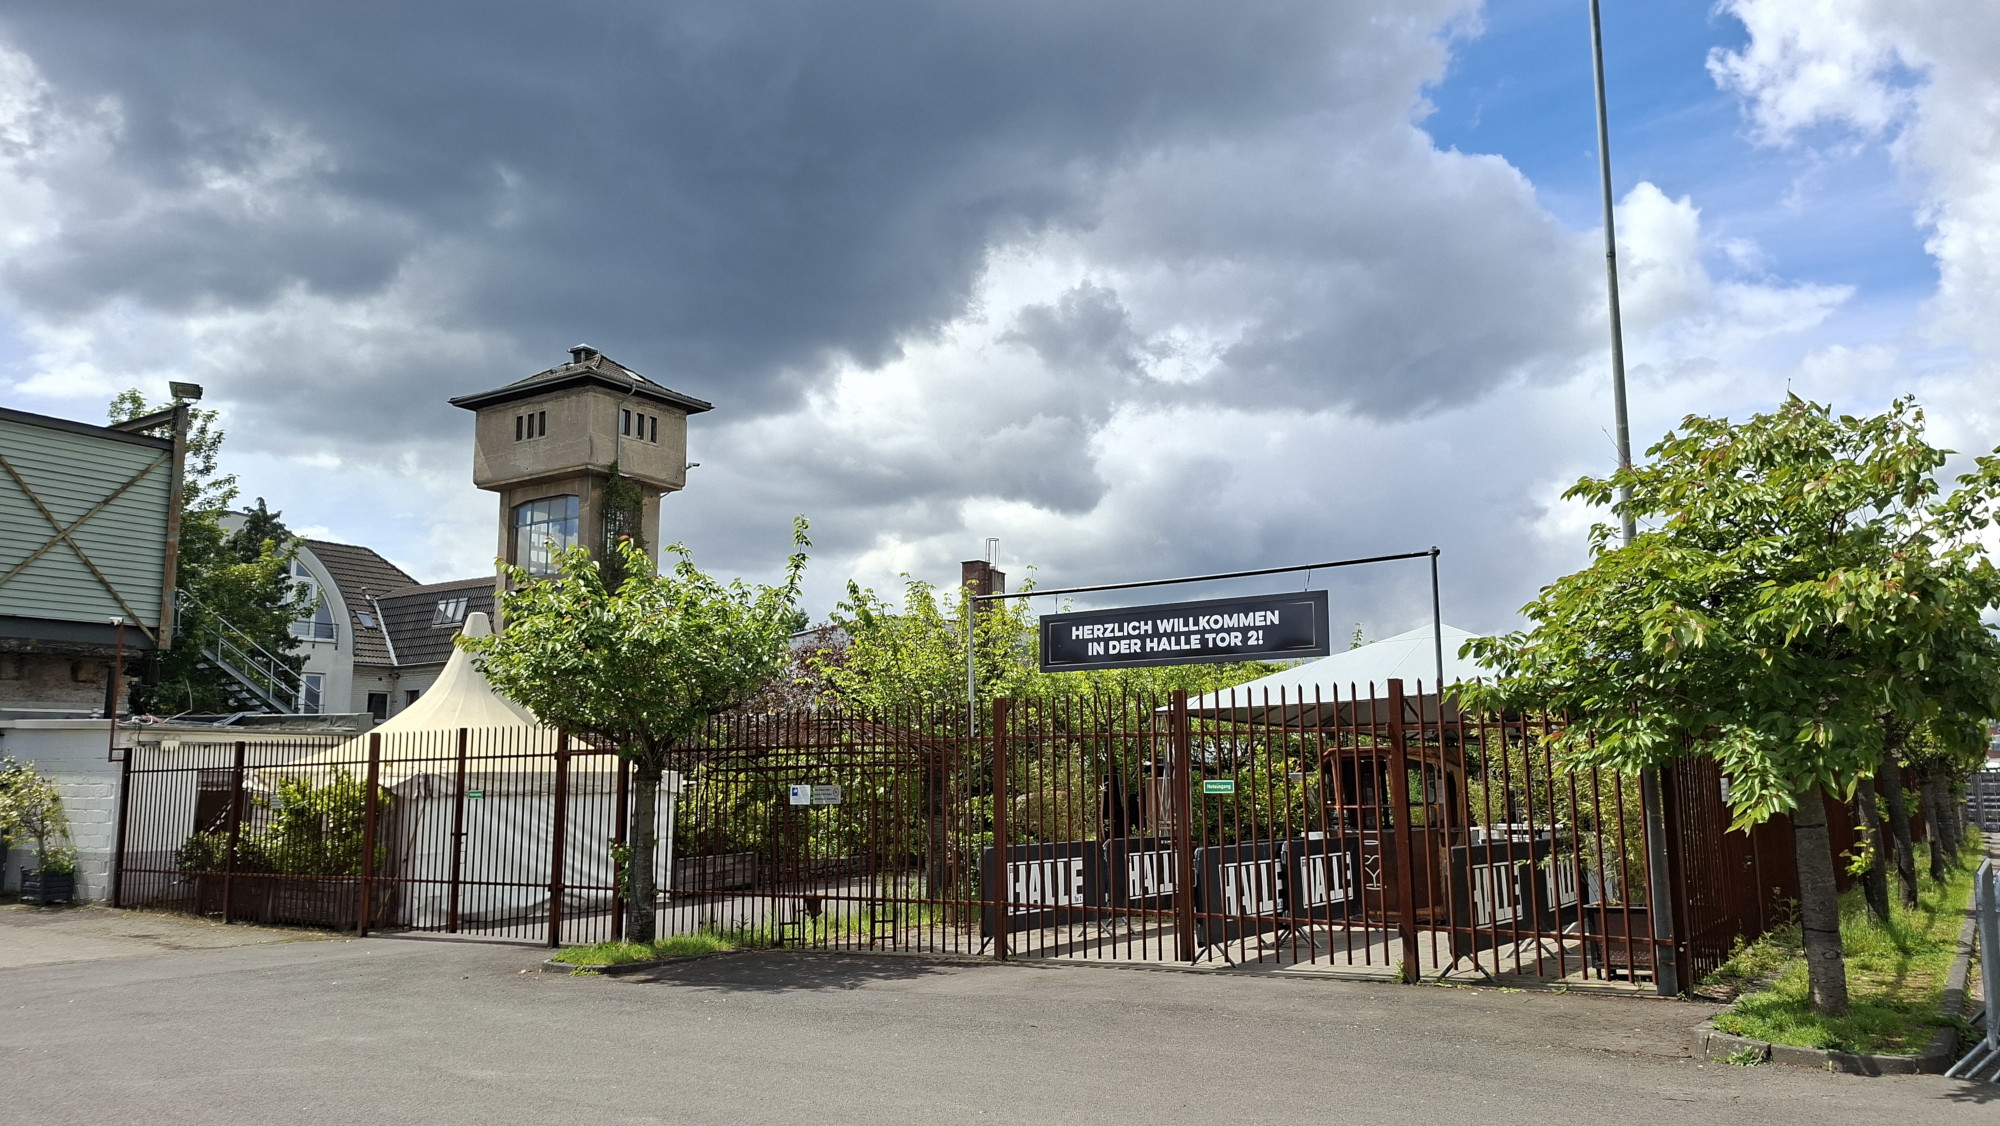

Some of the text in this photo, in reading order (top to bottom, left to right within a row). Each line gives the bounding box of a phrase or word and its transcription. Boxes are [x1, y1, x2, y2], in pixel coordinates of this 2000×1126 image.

[1071, 609, 1280, 640] HERZLICH WILLKOMMEN
[1087, 630, 1264, 656] IN DER HALLE TOR 2!
[1009, 860, 1084, 911] HALLE
[1128, 852, 1179, 897] HALL
